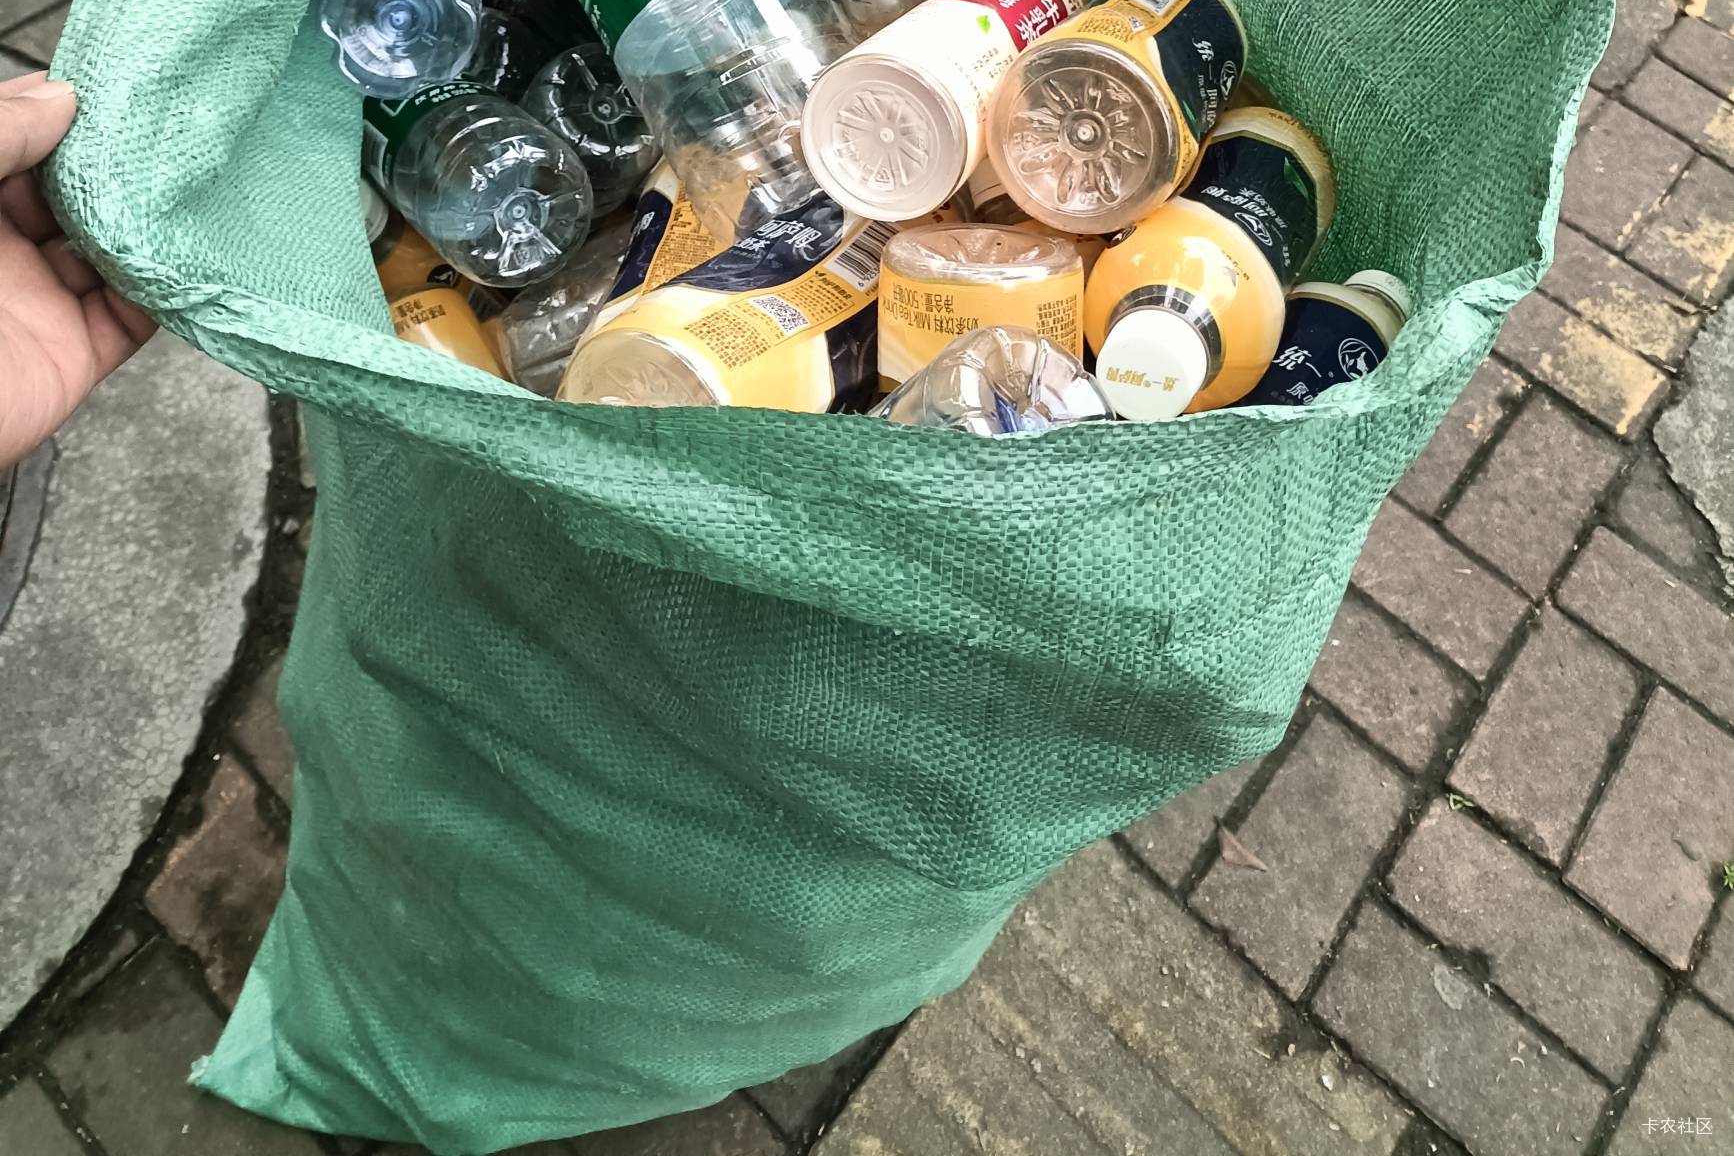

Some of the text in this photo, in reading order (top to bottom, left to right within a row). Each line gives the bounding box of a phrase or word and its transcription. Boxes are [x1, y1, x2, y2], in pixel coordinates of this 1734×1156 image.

[934, 315, 980, 335] 奶茶饮料
[1271, 345, 1323, 379] 统一
